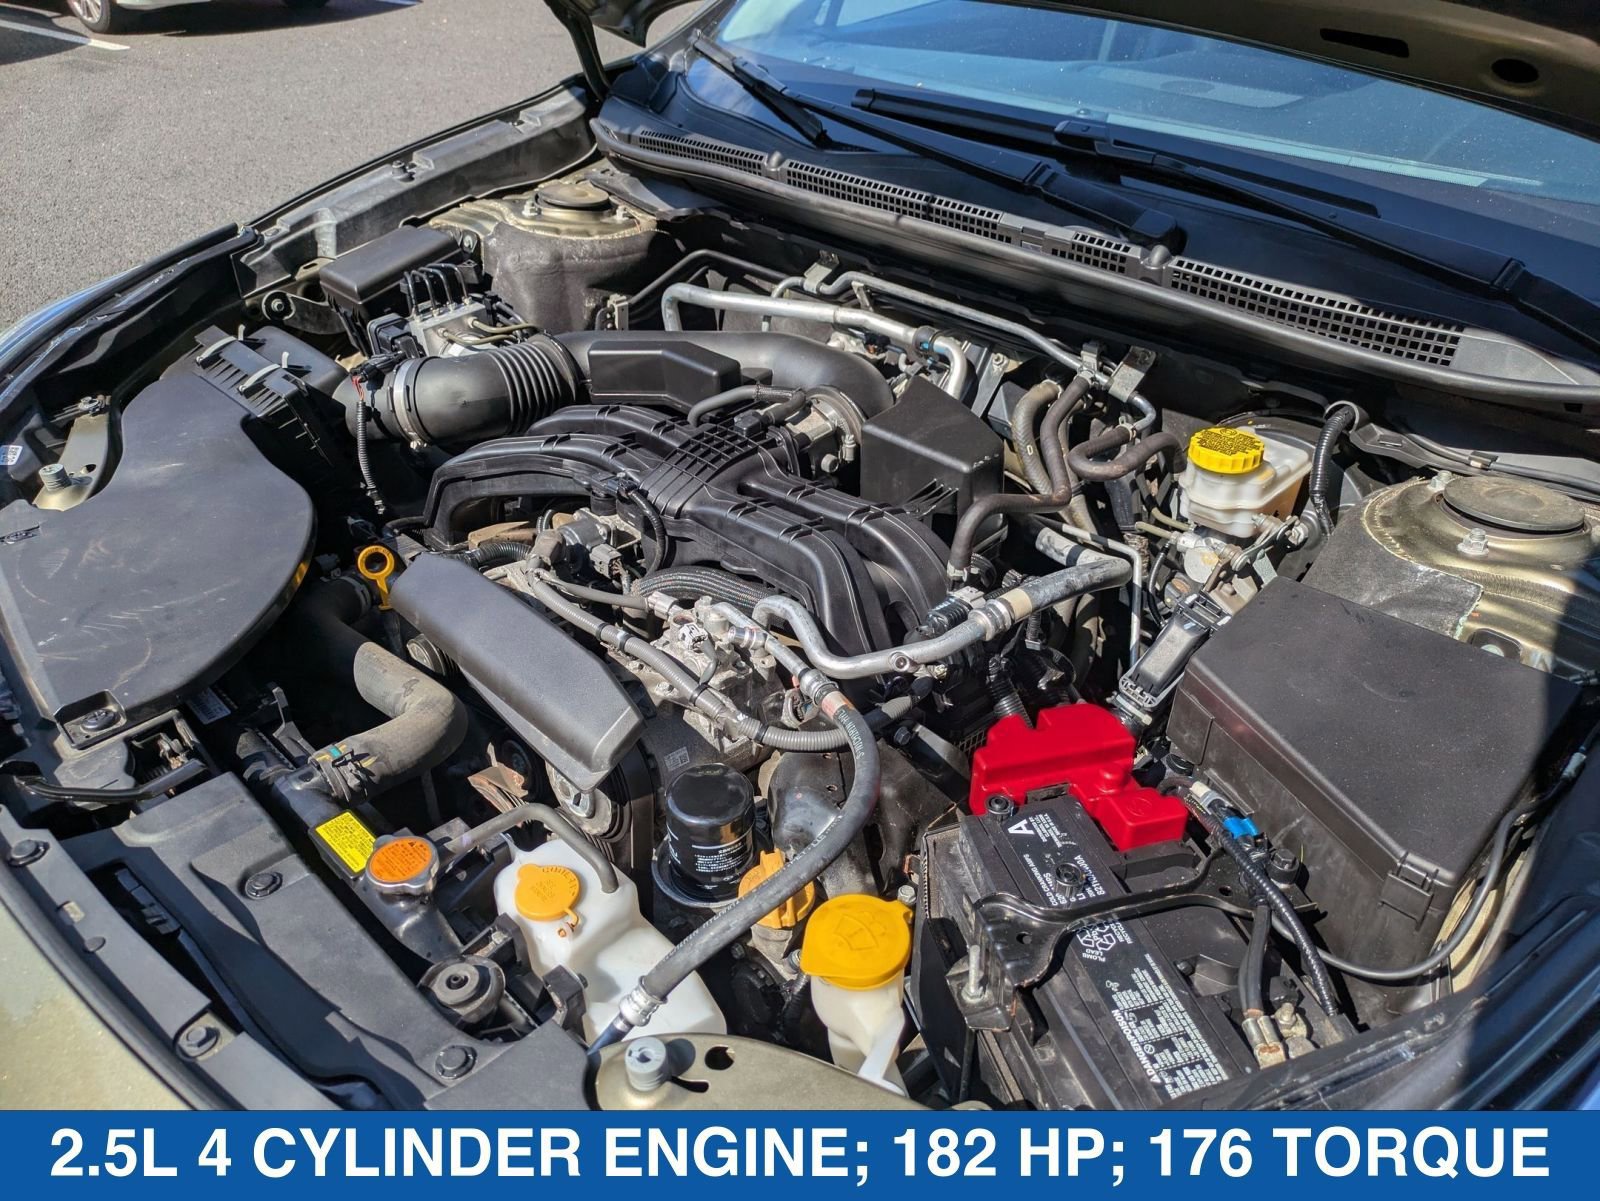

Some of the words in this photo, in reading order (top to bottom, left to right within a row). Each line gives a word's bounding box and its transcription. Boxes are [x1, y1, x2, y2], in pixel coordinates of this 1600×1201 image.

[1007, 819, 1035, 835] A
[1023, 853, 1035, 867] AMPS
[1030, 866, 1050, 892] CRANKING
[1045, 891, 1058, 906] COLD
[1085, 948, 1103, 956] LEAD
